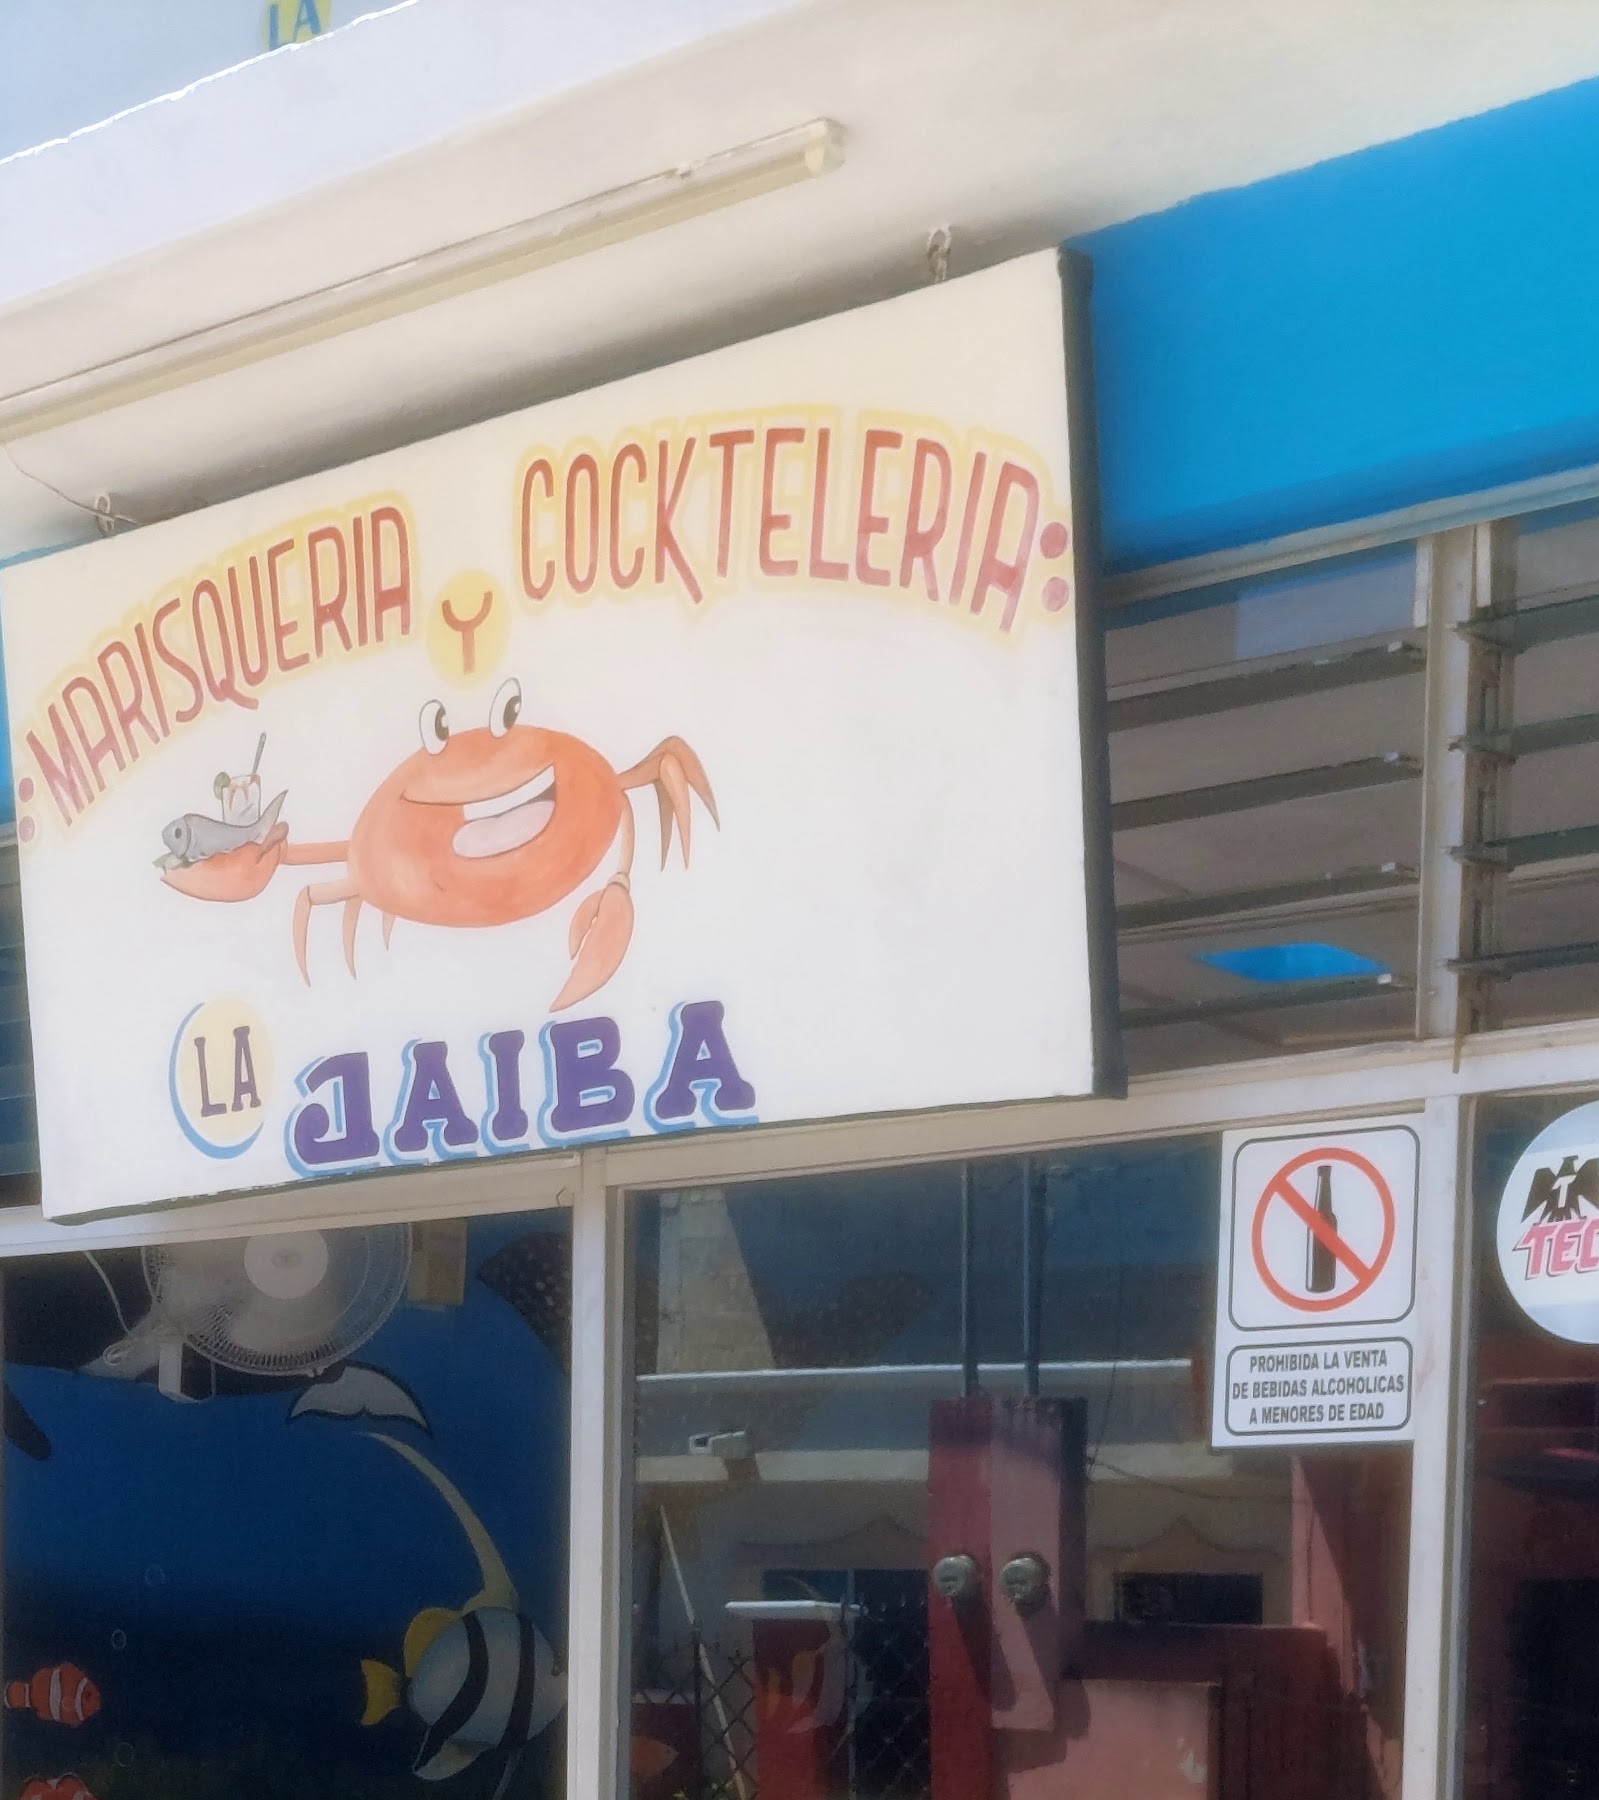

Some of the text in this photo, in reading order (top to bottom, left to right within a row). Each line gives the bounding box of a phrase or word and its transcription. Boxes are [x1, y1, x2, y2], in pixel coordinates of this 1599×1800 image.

[443, 591, 494, 673] Y
[193, 999, 758, 1172] LA JAIBA
[1249, 1349, 1388, 1374] PROHIBIDA LA VENTA
[1232, 1374, 1404, 1400] DE BEBIDAS ALCOHOLICAS
[1249, 1402, 1385, 1425] A MENORES DE EDAD
